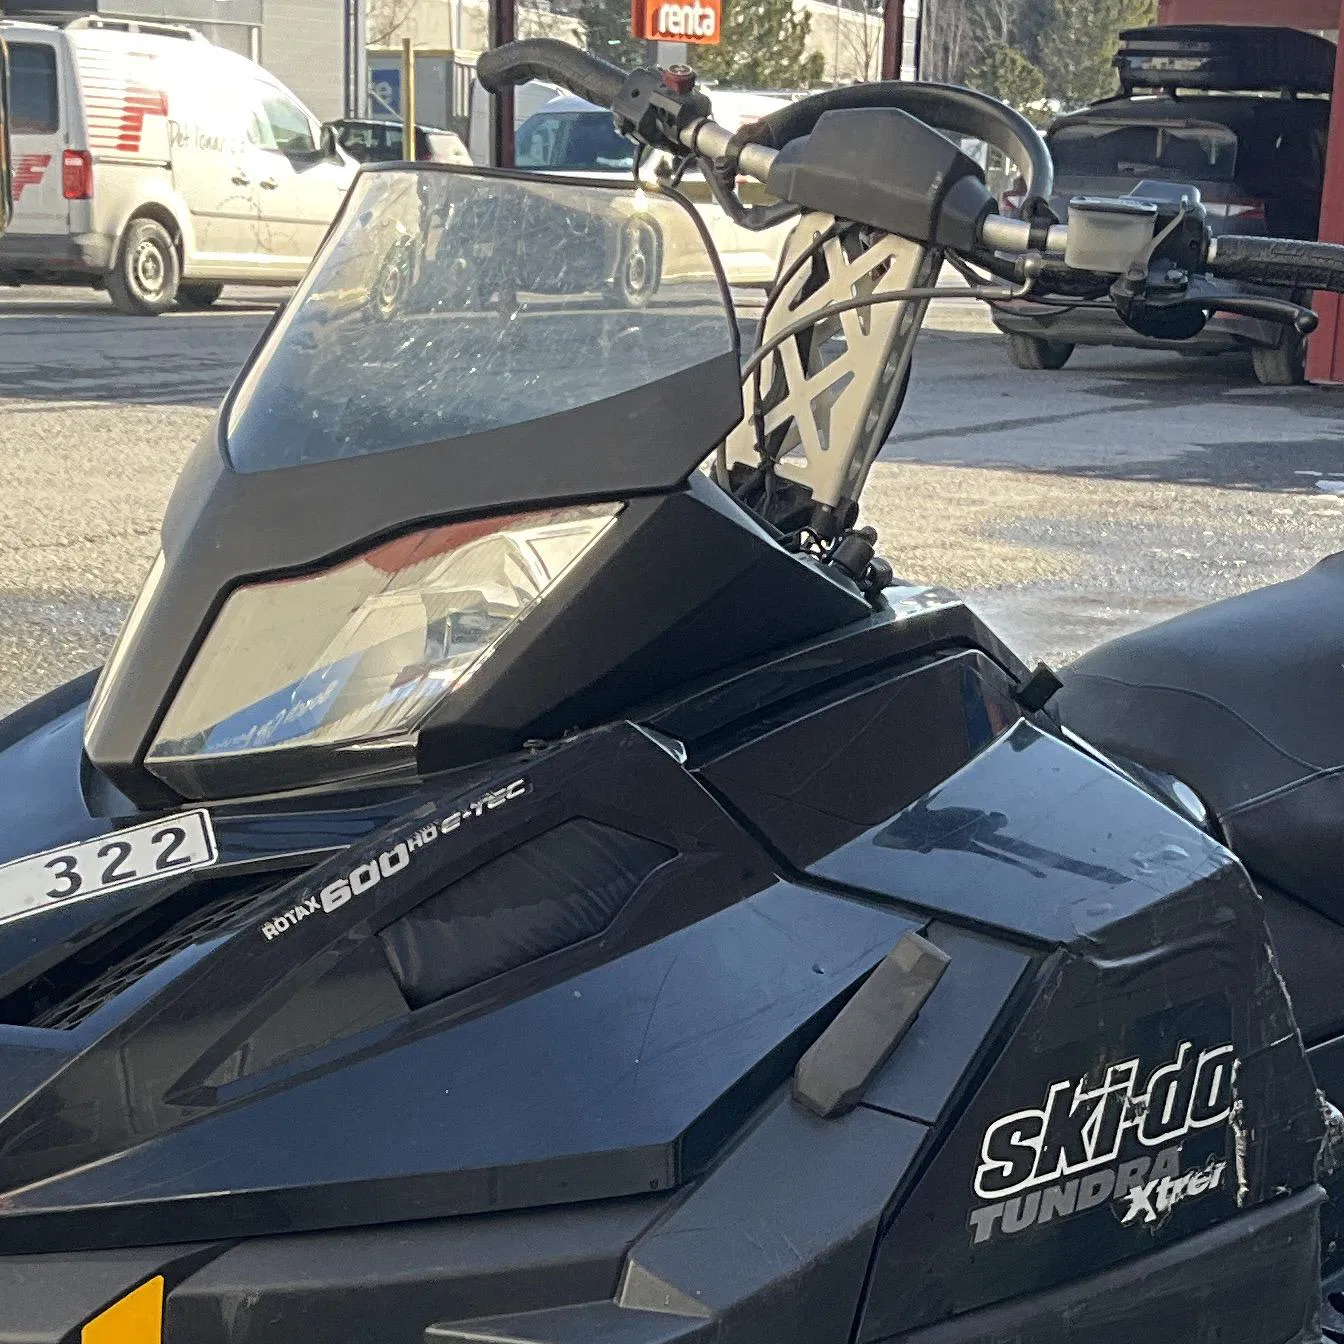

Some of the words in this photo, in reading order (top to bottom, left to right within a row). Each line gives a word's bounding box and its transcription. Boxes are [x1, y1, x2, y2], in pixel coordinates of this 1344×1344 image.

[658, 0, 716, 36] renta
[43, 826, 192, 899] 322
[261, 894, 321, 941] ROTAX
[440, 777, 529, 834] E-TEC
[968, 1144, 1182, 1244] TUNDRA
